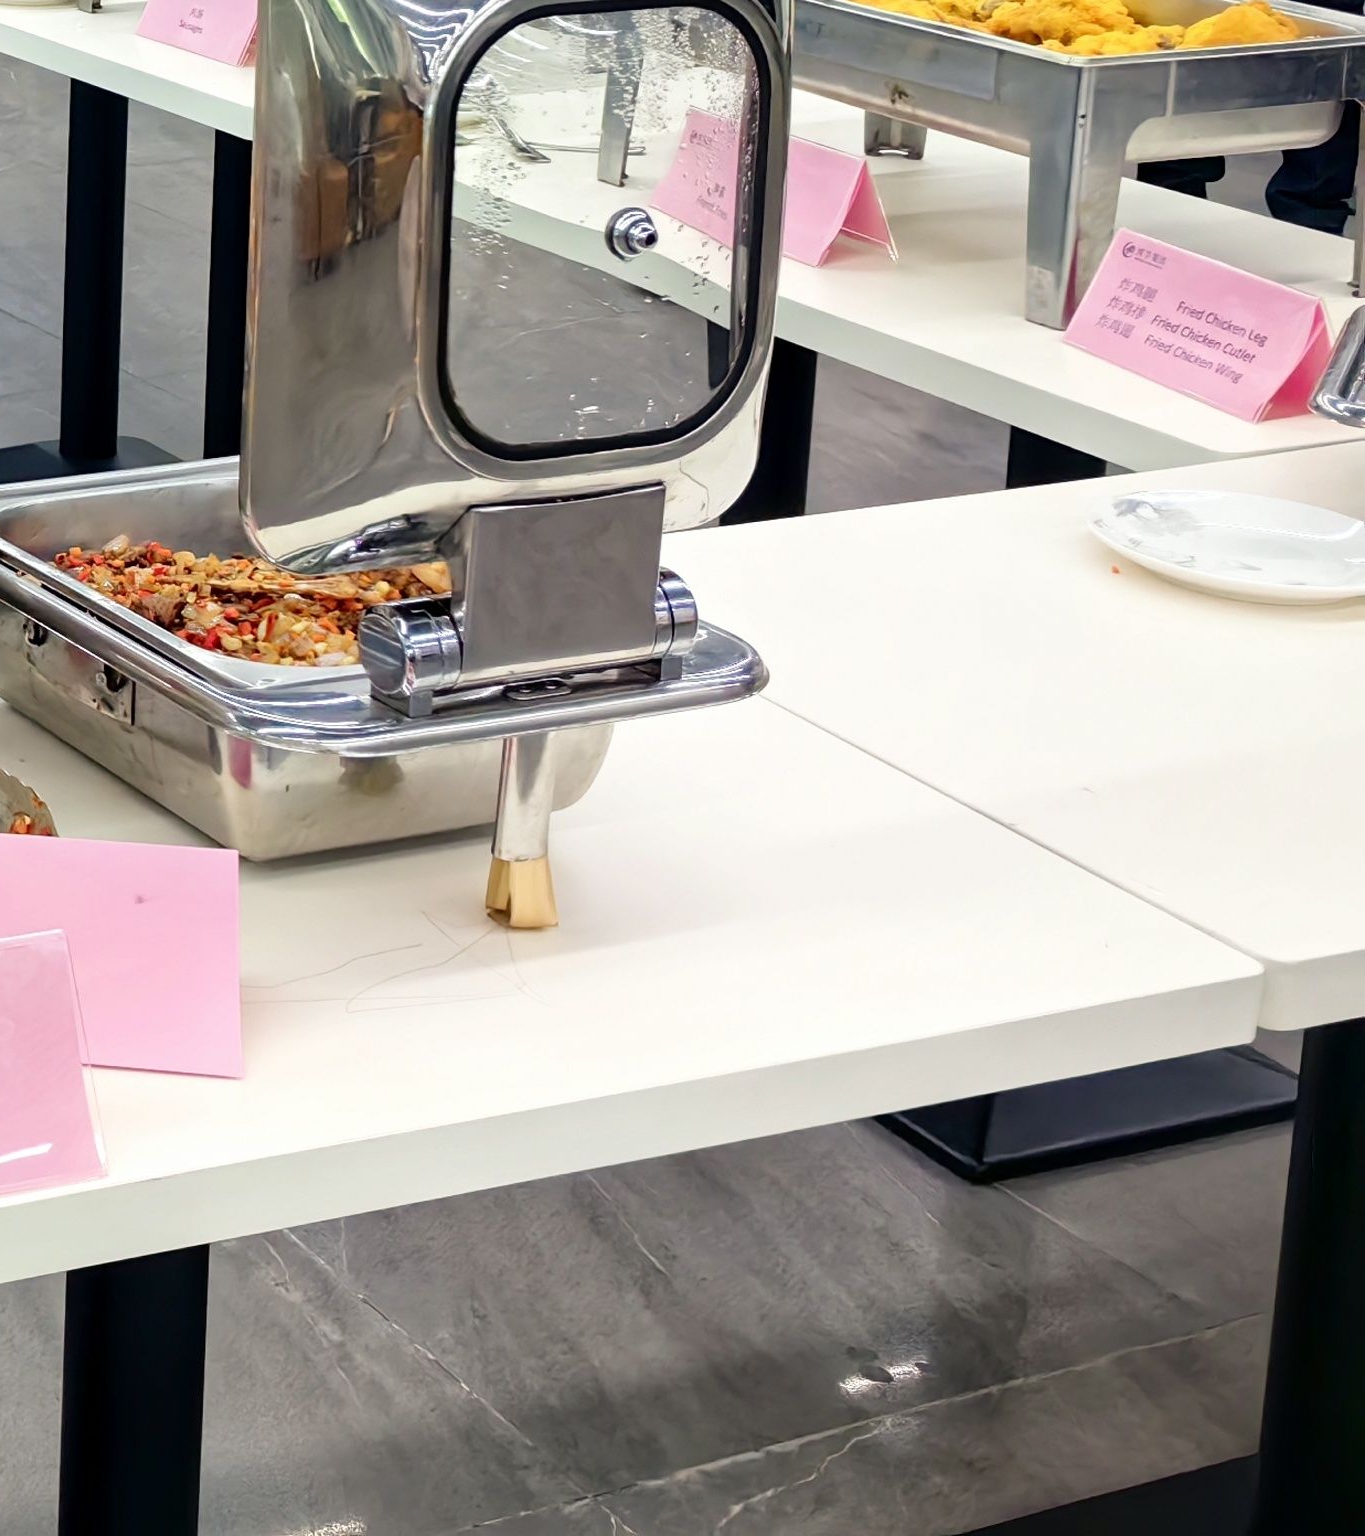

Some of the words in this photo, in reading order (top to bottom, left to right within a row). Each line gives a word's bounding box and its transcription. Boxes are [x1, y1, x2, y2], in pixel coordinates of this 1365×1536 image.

[1150, 314, 1178, 335] Fried
[1180, 325, 1221, 350] Chicken
[1223, 342, 1256, 364] Cutlet
[1176, 301, 1203, 320] Fried
[1205, 311, 1248, 338] Chicken
[1248, 327, 1269, 348] Leg
[1144, 334, 1173, 354] Fried
[1173, 346, 1214, 371] Chicken
